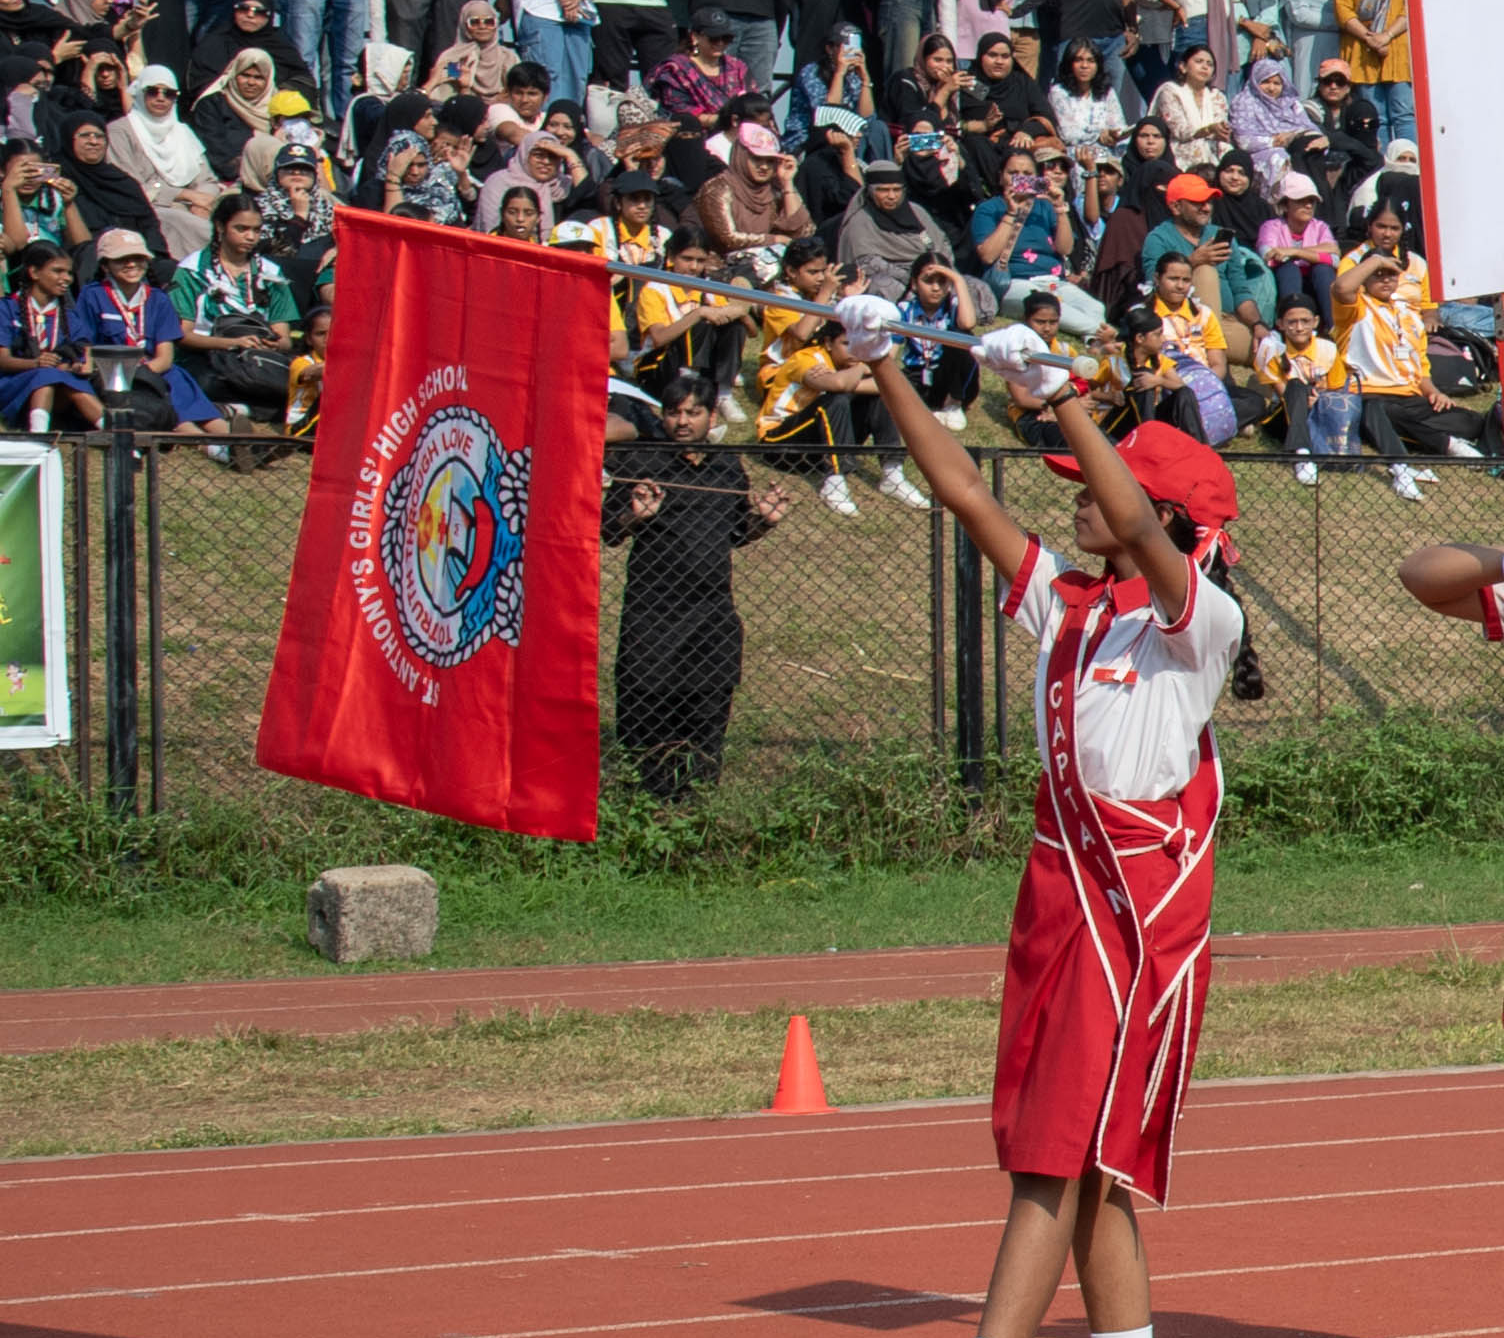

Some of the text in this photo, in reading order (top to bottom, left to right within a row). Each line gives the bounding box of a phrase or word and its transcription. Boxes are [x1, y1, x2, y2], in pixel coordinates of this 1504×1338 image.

[372, 397, 419, 460] HIGH
[418, 365, 468, 408] SCHOOL
[350, 457, 382, 549] GIRLS'
[405, 440, 439, 564] THROUGH
[441, 427, 474, 457] LOVE
[352, 558, 420, 692] ANTHONY'S
[1049, 680, 1131, 915] CAPTAIN
